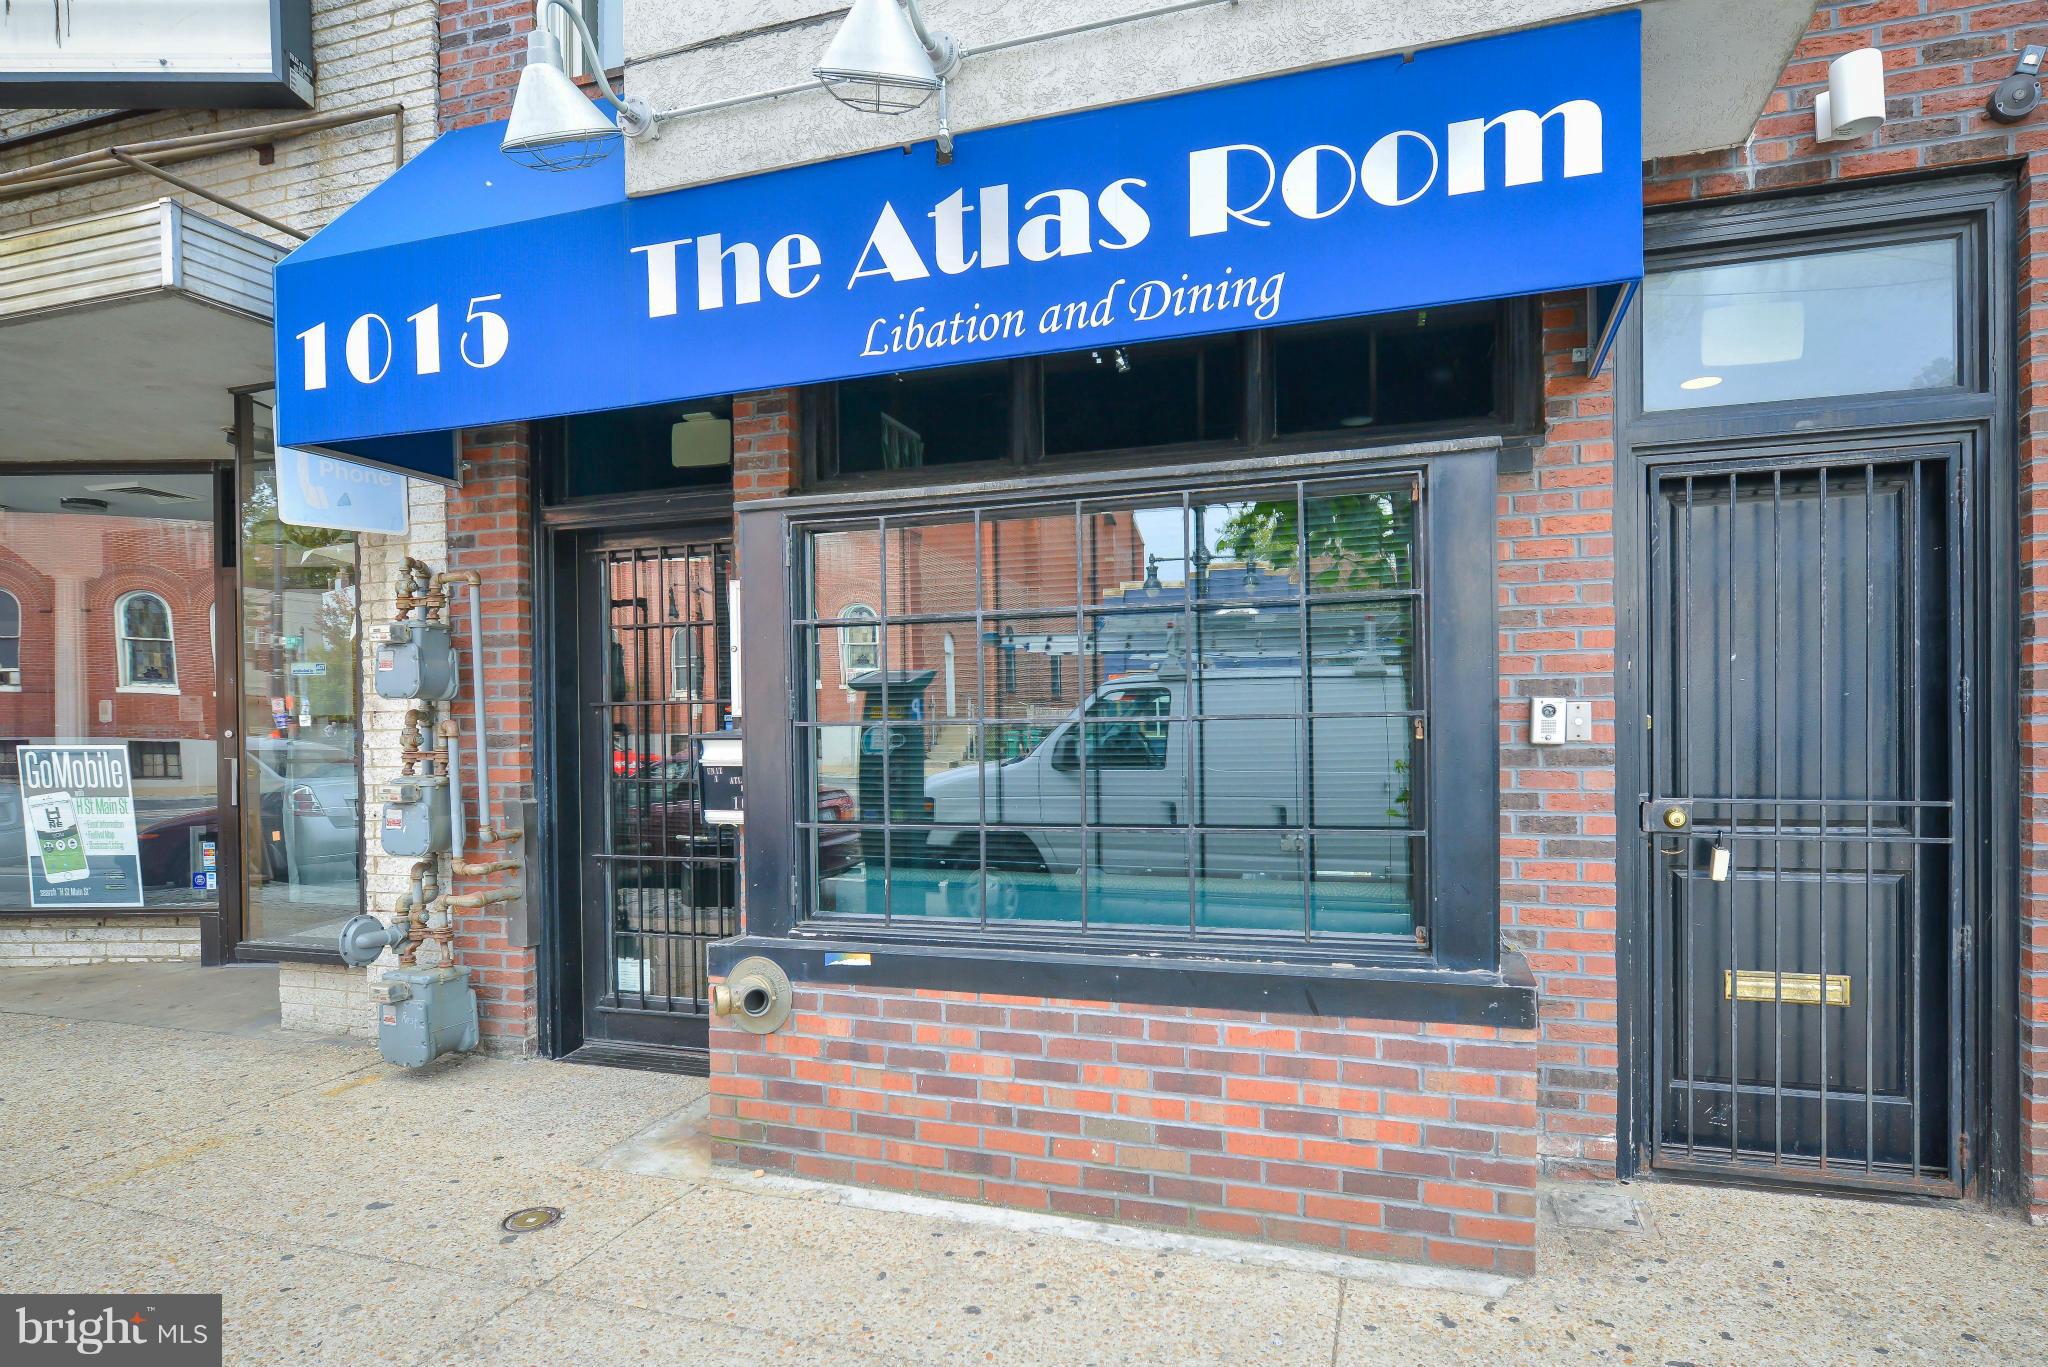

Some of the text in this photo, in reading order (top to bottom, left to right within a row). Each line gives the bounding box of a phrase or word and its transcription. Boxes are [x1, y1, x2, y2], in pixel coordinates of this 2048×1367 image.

[630, 99, 1603, 318] The Atlas Room
[860, 266, 1286, 358] Libation and Dining
[295, 293, 509, 391] 1015
[319, 459, 392, 487] Phone
[25, 751, 123, 788] GoMobile
[729, 777, 743, 785] ATL
[76, 798, 129, 815] H St Main St
